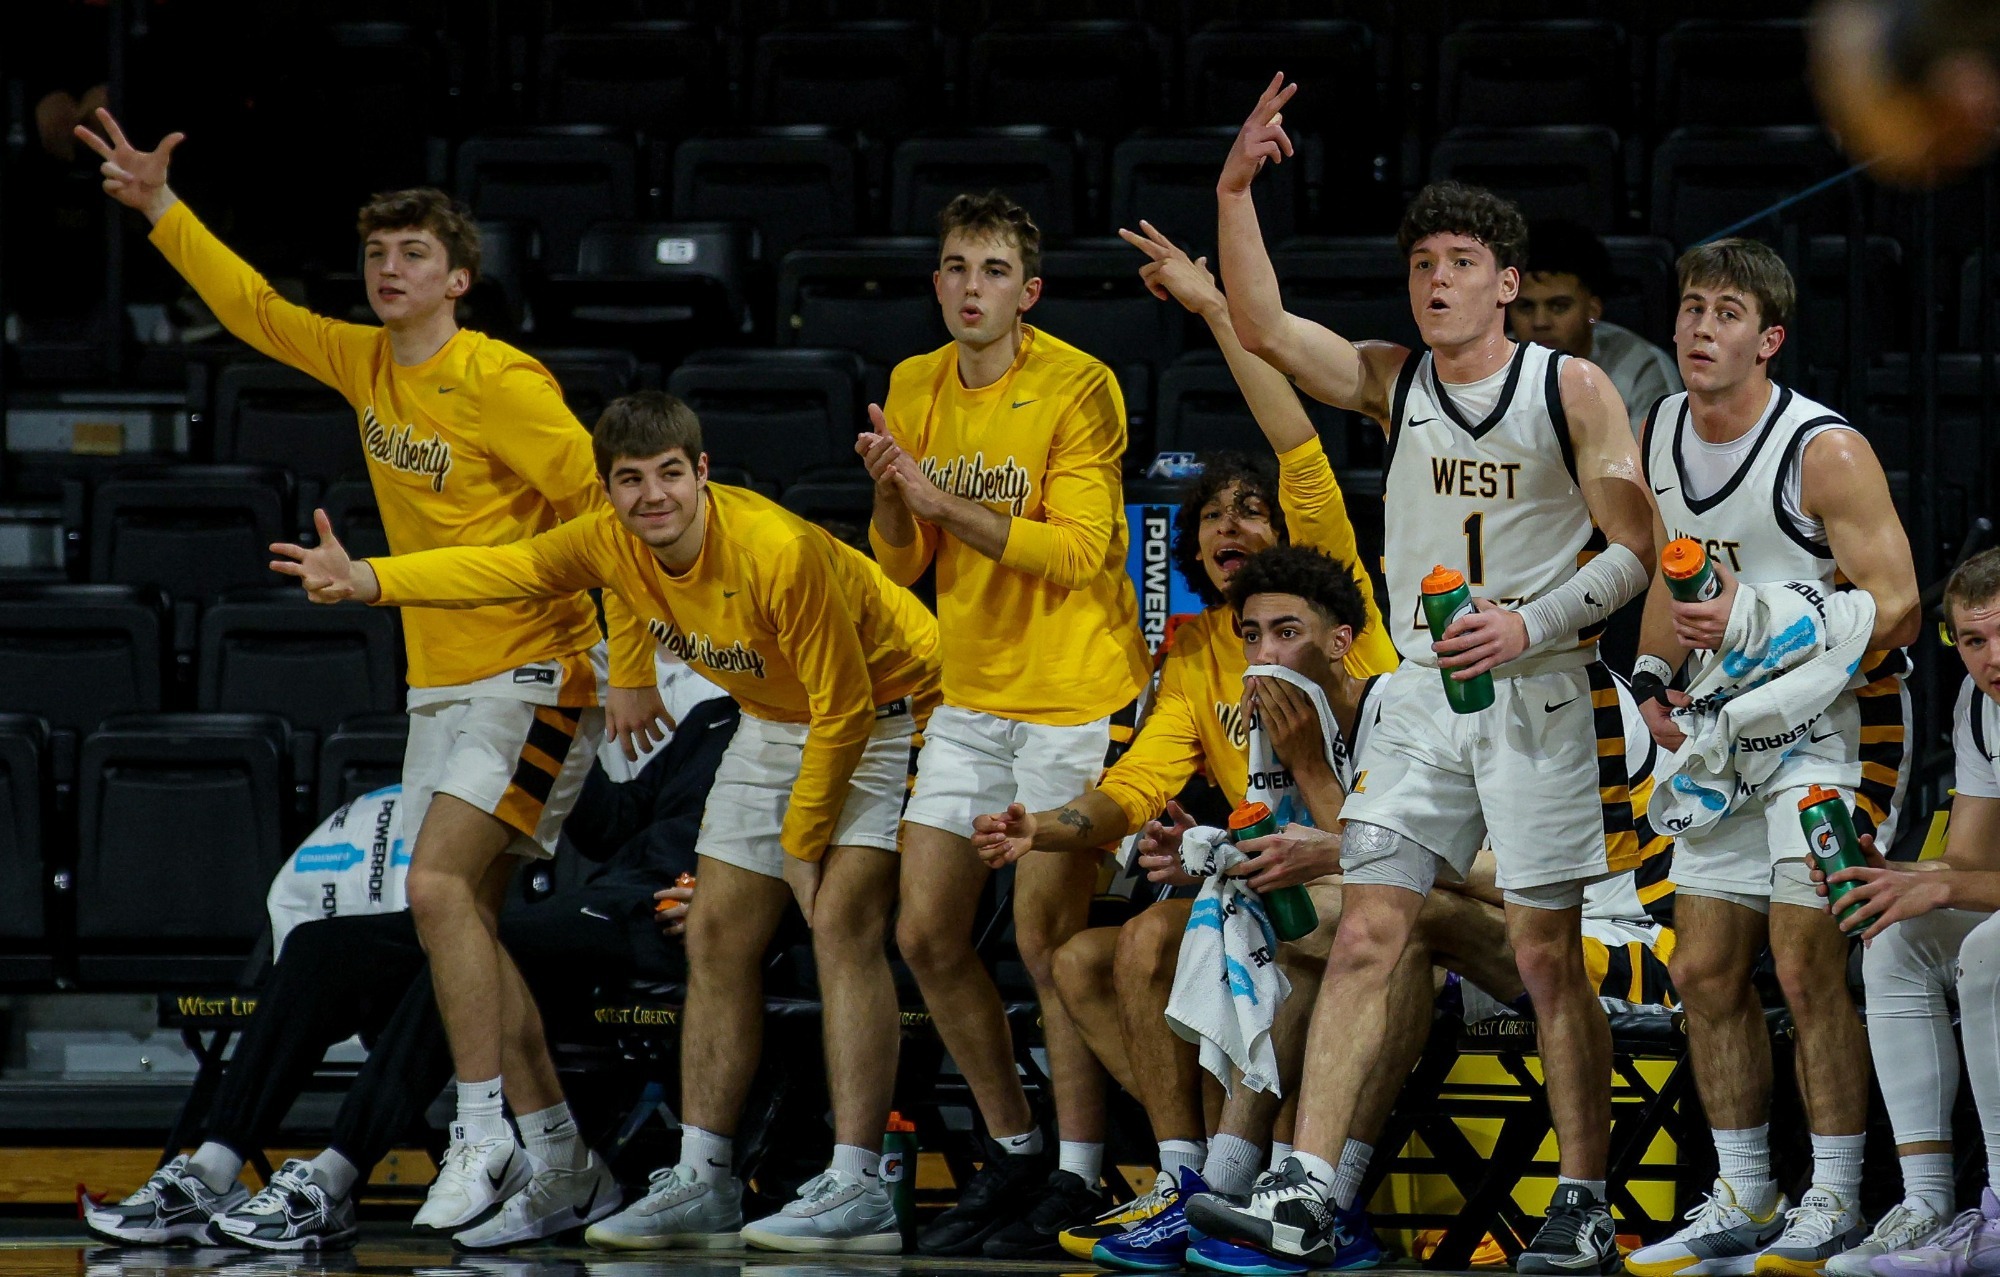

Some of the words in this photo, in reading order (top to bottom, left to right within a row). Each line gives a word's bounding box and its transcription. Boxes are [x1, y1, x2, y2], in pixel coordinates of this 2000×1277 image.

[952, 452, 1031, 517] Liberty
[1430, 456, 1521, 500] WEST
[1462, 511, 1485, 587] 1
[368, 799, 396, 905] POWERADE
[1810, 821, 1841, 859] G
[177, 996, 225, 1016] WEST
